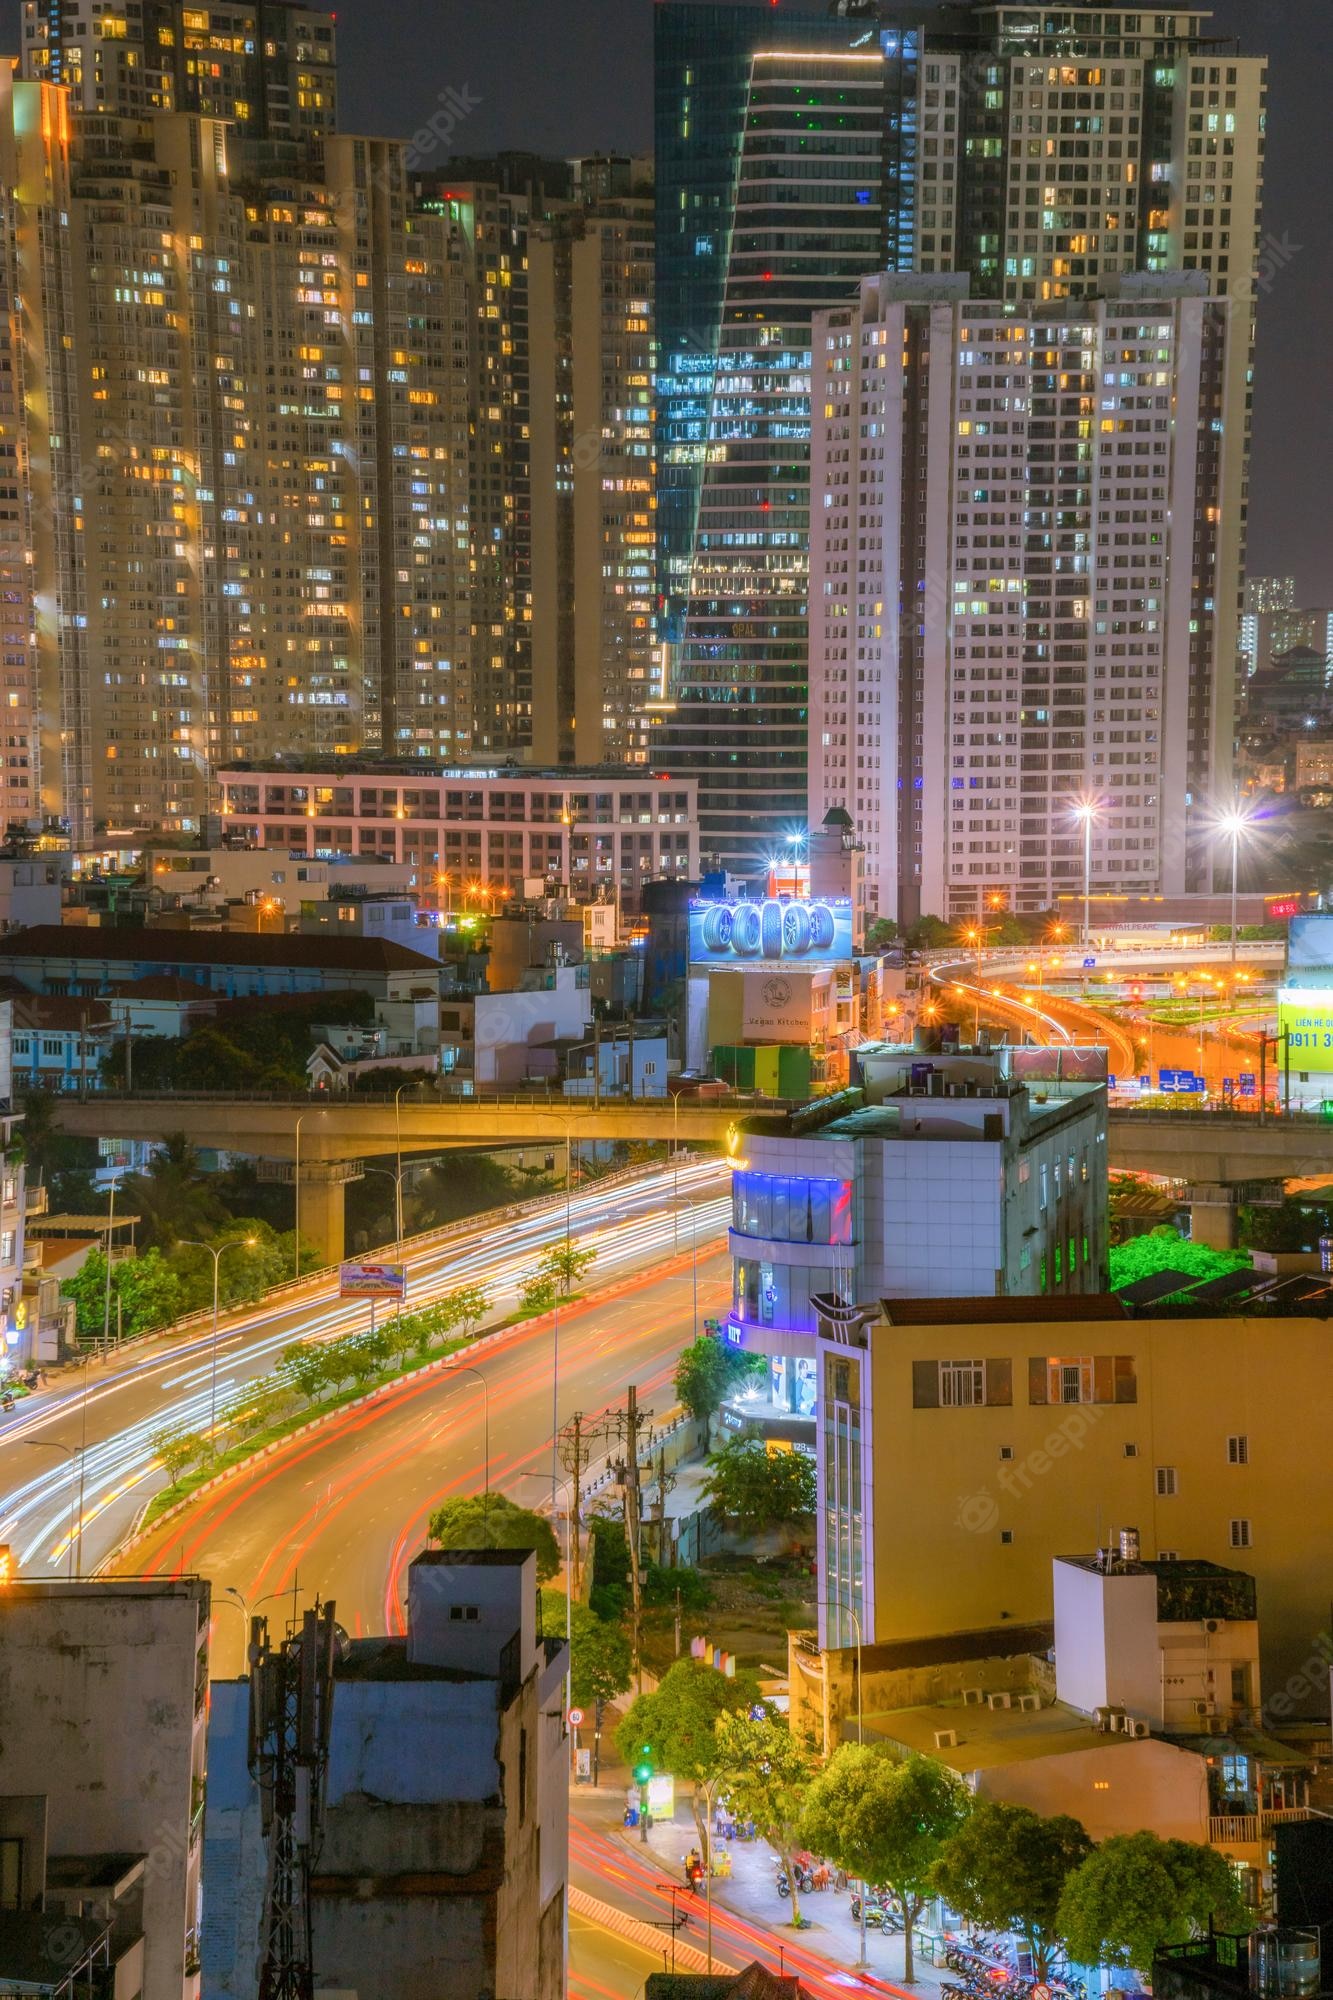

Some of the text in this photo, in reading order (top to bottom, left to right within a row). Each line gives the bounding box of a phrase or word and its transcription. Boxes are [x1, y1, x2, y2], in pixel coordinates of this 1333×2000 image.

[732, 622, 756, 637] OPAL
[777, 1017, 809, 1026] Kitchen
[1288, 1033, 1333, 1047] 0911 3
